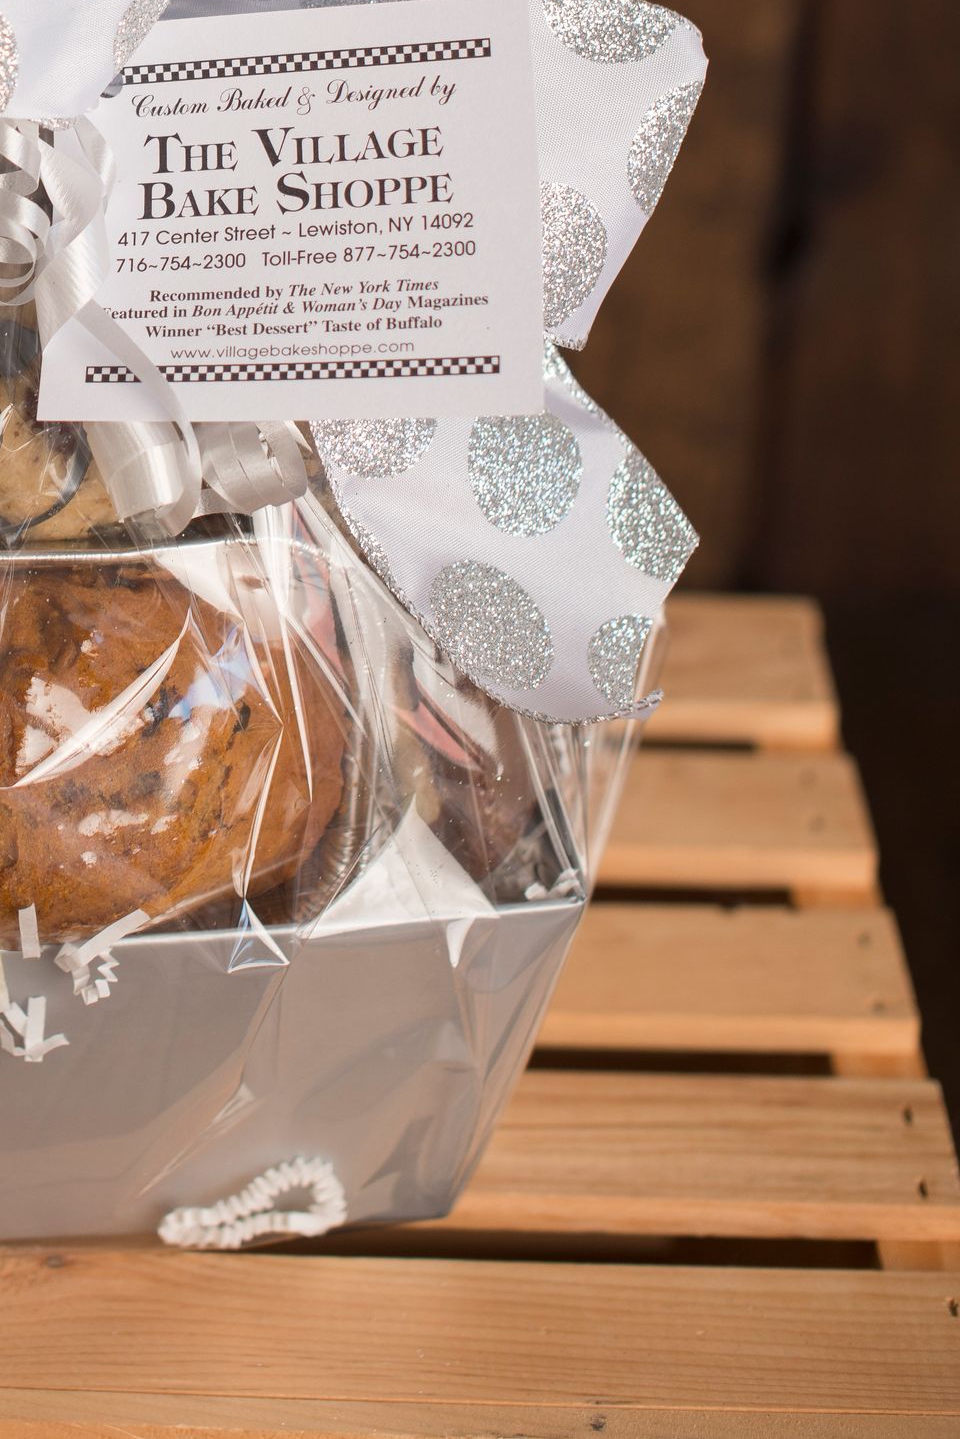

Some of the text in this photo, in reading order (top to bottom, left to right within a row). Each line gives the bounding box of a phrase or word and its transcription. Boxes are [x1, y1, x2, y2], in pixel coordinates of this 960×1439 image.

[132, 75, 456, 117] Custom Baked & Designed by
[144, 126, 444, 174] THE VILLAGE
[137, 171, 454, 220] BAKE SHOPPE
[118, 231, 149, 246] 417
[156, 229, 219, 245] Center
[224, 224, 276, 241] Street
[299, 220, 382, 237] Lewiston,
[389, 216, 413, 232] NY
[422, 212, 473, 230] 14092
[262, 250, 337, 266] Toll-Free
[150, 279, 438, 302] Recommended by The New York Times
[173, 306, 187, 317] in
[192, 305, 221, 317] Bon
[225, 302, 278, 319] Appétit
[283, 302, 295, 314] &
[373, 297, 401, 313] Day
[408, 294, 488, 310] Magazines
[146, 326, 202, 337] Winner
[322, 320, 361, 332] Taste
[367, 318, 382, 330] of
[387, 316, 442, 329] Buffalo
[171, 340, 414, 359] www.villagebakeshoppe.com
